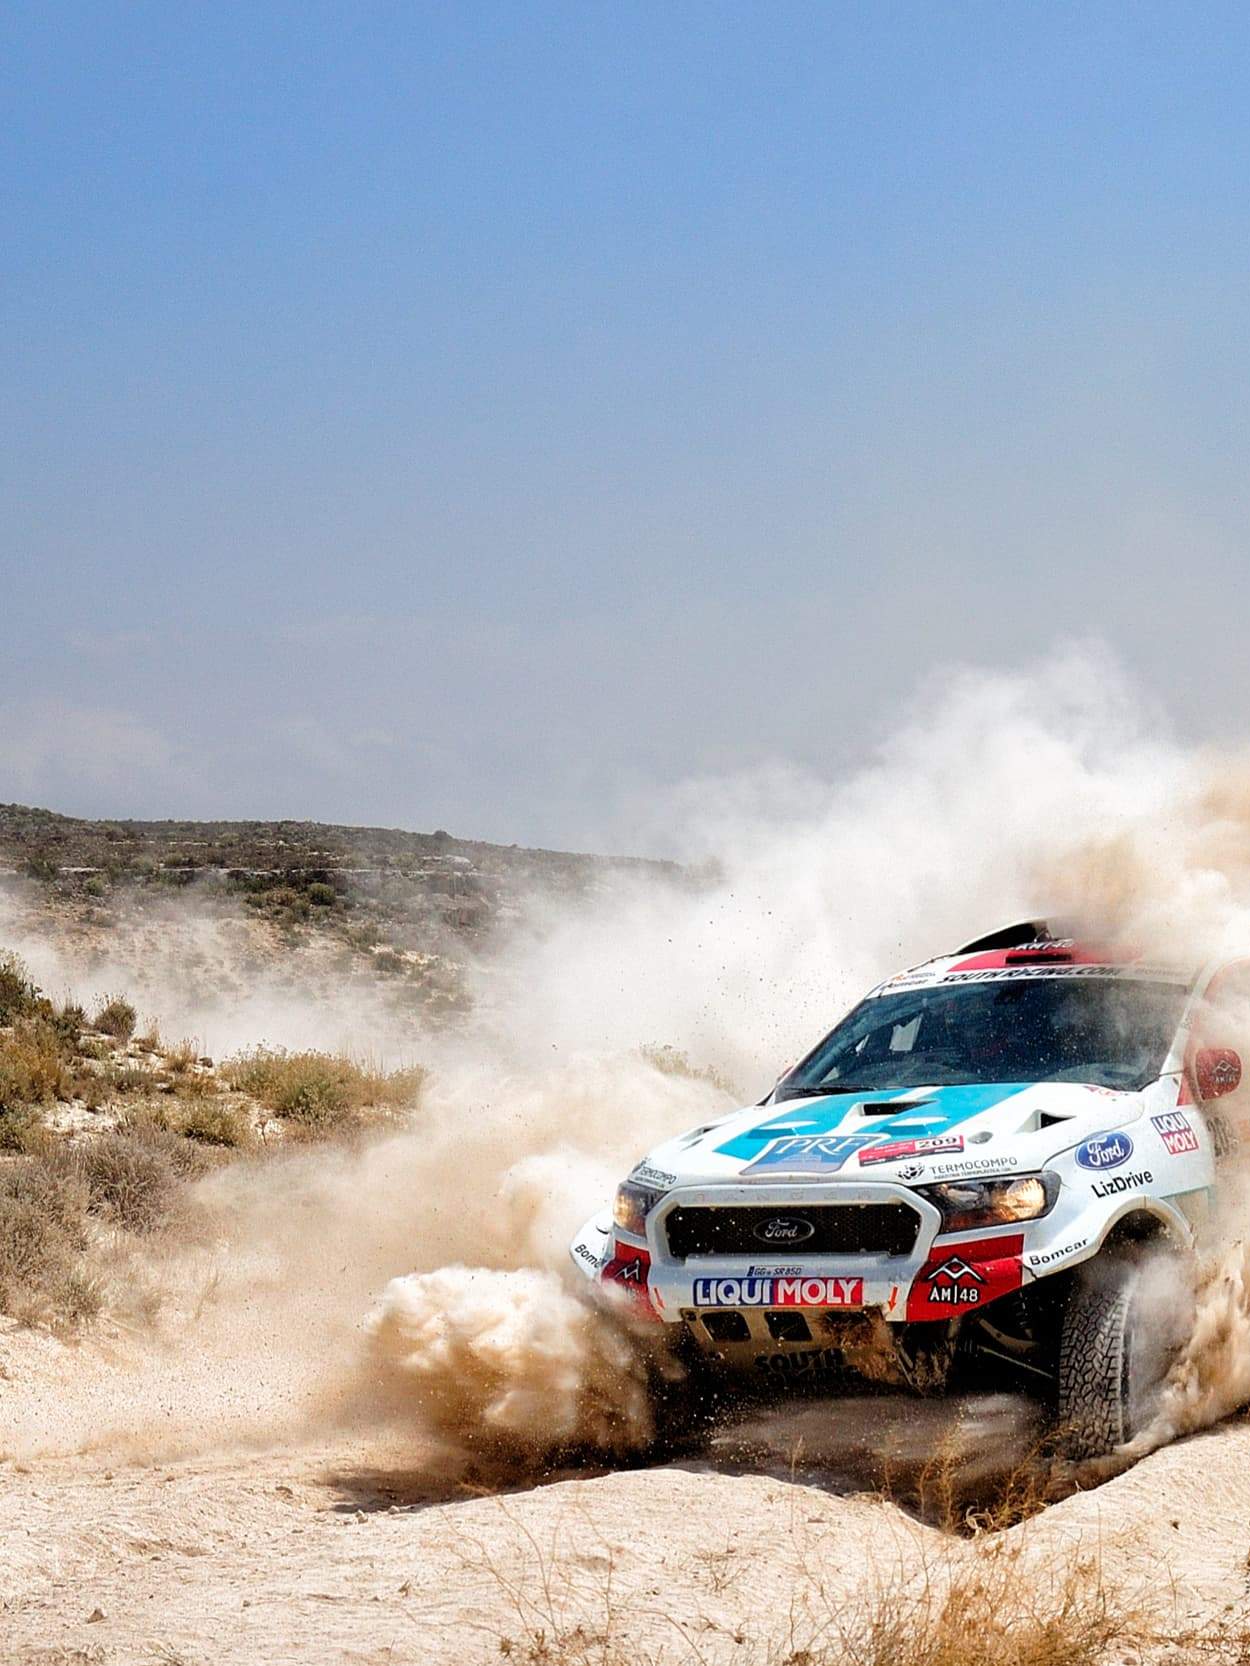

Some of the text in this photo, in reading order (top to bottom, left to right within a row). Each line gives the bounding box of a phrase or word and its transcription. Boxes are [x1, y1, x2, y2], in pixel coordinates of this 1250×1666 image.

[1152, 1112, 1191, 1133] LIQUI
[918, 1136, 958, 1149] 209
[1086, 1136, 1126, 1166] Ford
[1163, 1131, 1198, 1155] MOLY
[930, 1156, 1018, 1174] TERMOCOMPO
[1091, 1170, 1154, 1199] LizDrive
[764, 1218, 799, 1239] Ford
[1029, 1237, 1089, 1267] Bomcar
[696, 1279, 860, 1306] LIQUI MOLY
